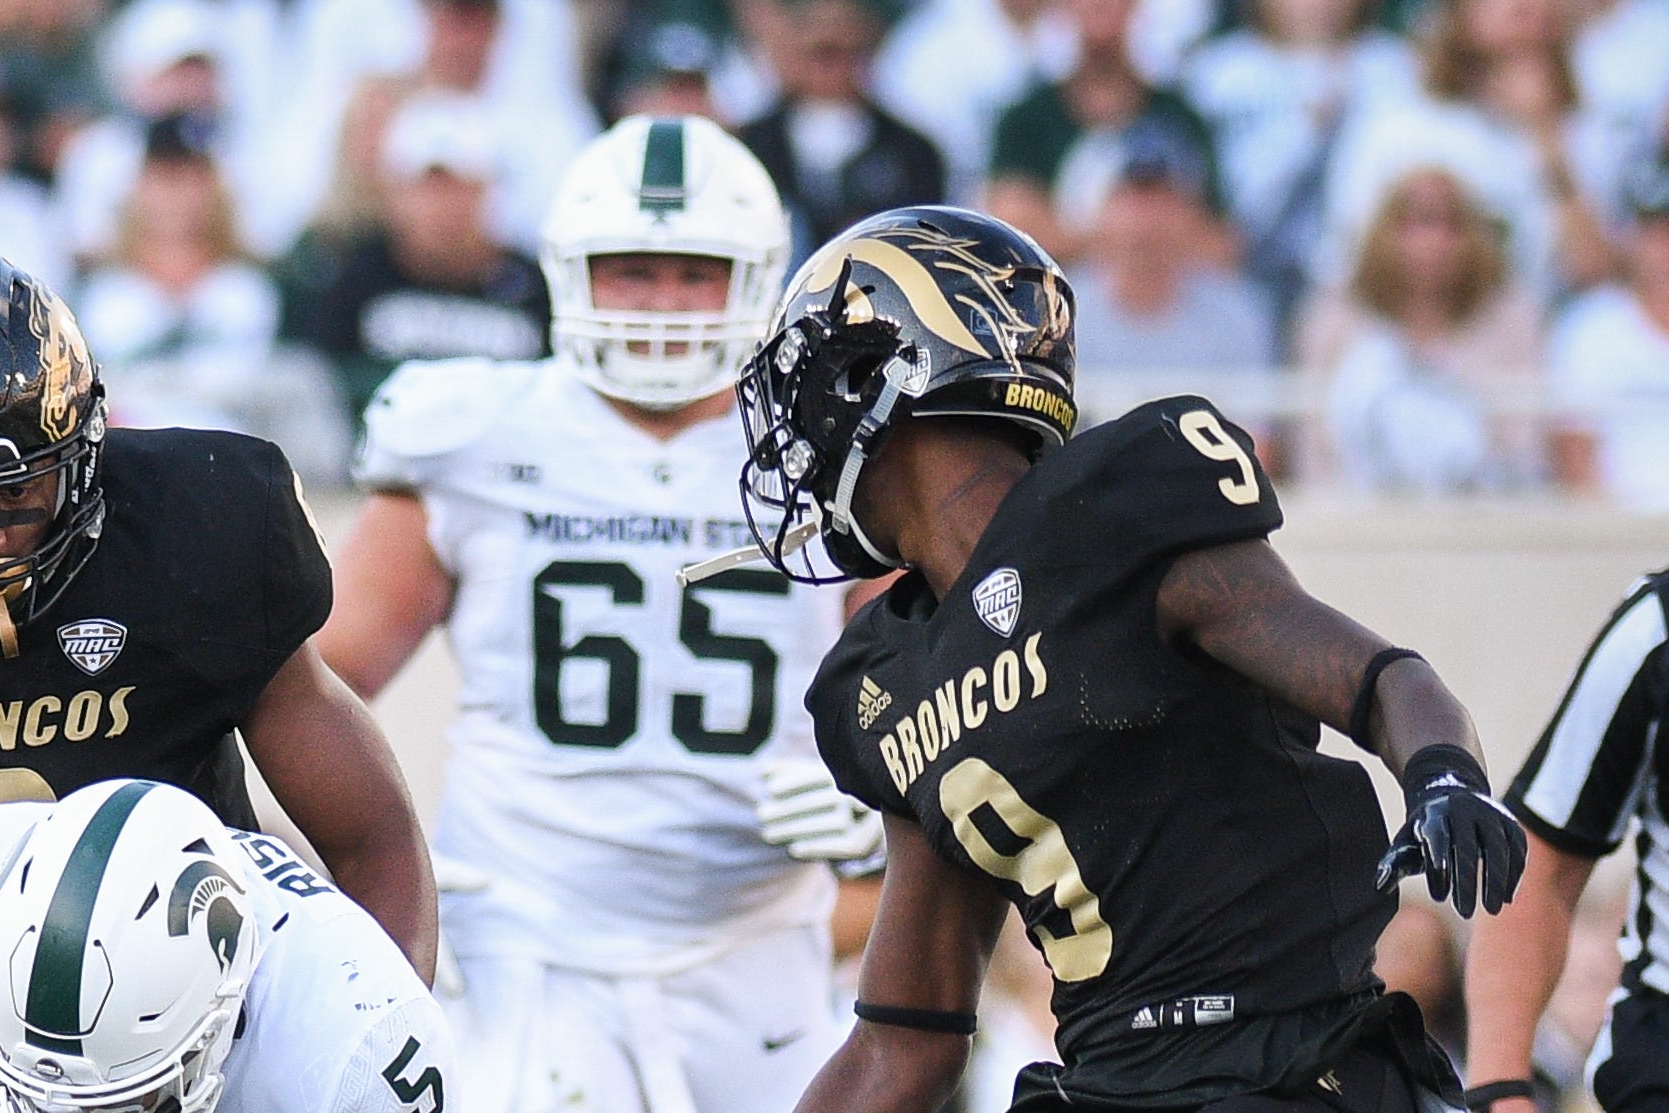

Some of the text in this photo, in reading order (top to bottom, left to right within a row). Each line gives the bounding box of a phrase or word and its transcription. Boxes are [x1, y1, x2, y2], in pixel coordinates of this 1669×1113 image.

[1005, 383, 1075, 431] BRONCOS
[1178, 410, 1260, 506] 9
[978, 586, 1020, 616] MAC
[64, 638, 122, 653] MAC
[533, 560, 791, 755] 65
[859, 692, 892, 730] adidas
[879, 631, 1048, 797] BRONCOS
[939, 757, 1113, 983] 9
